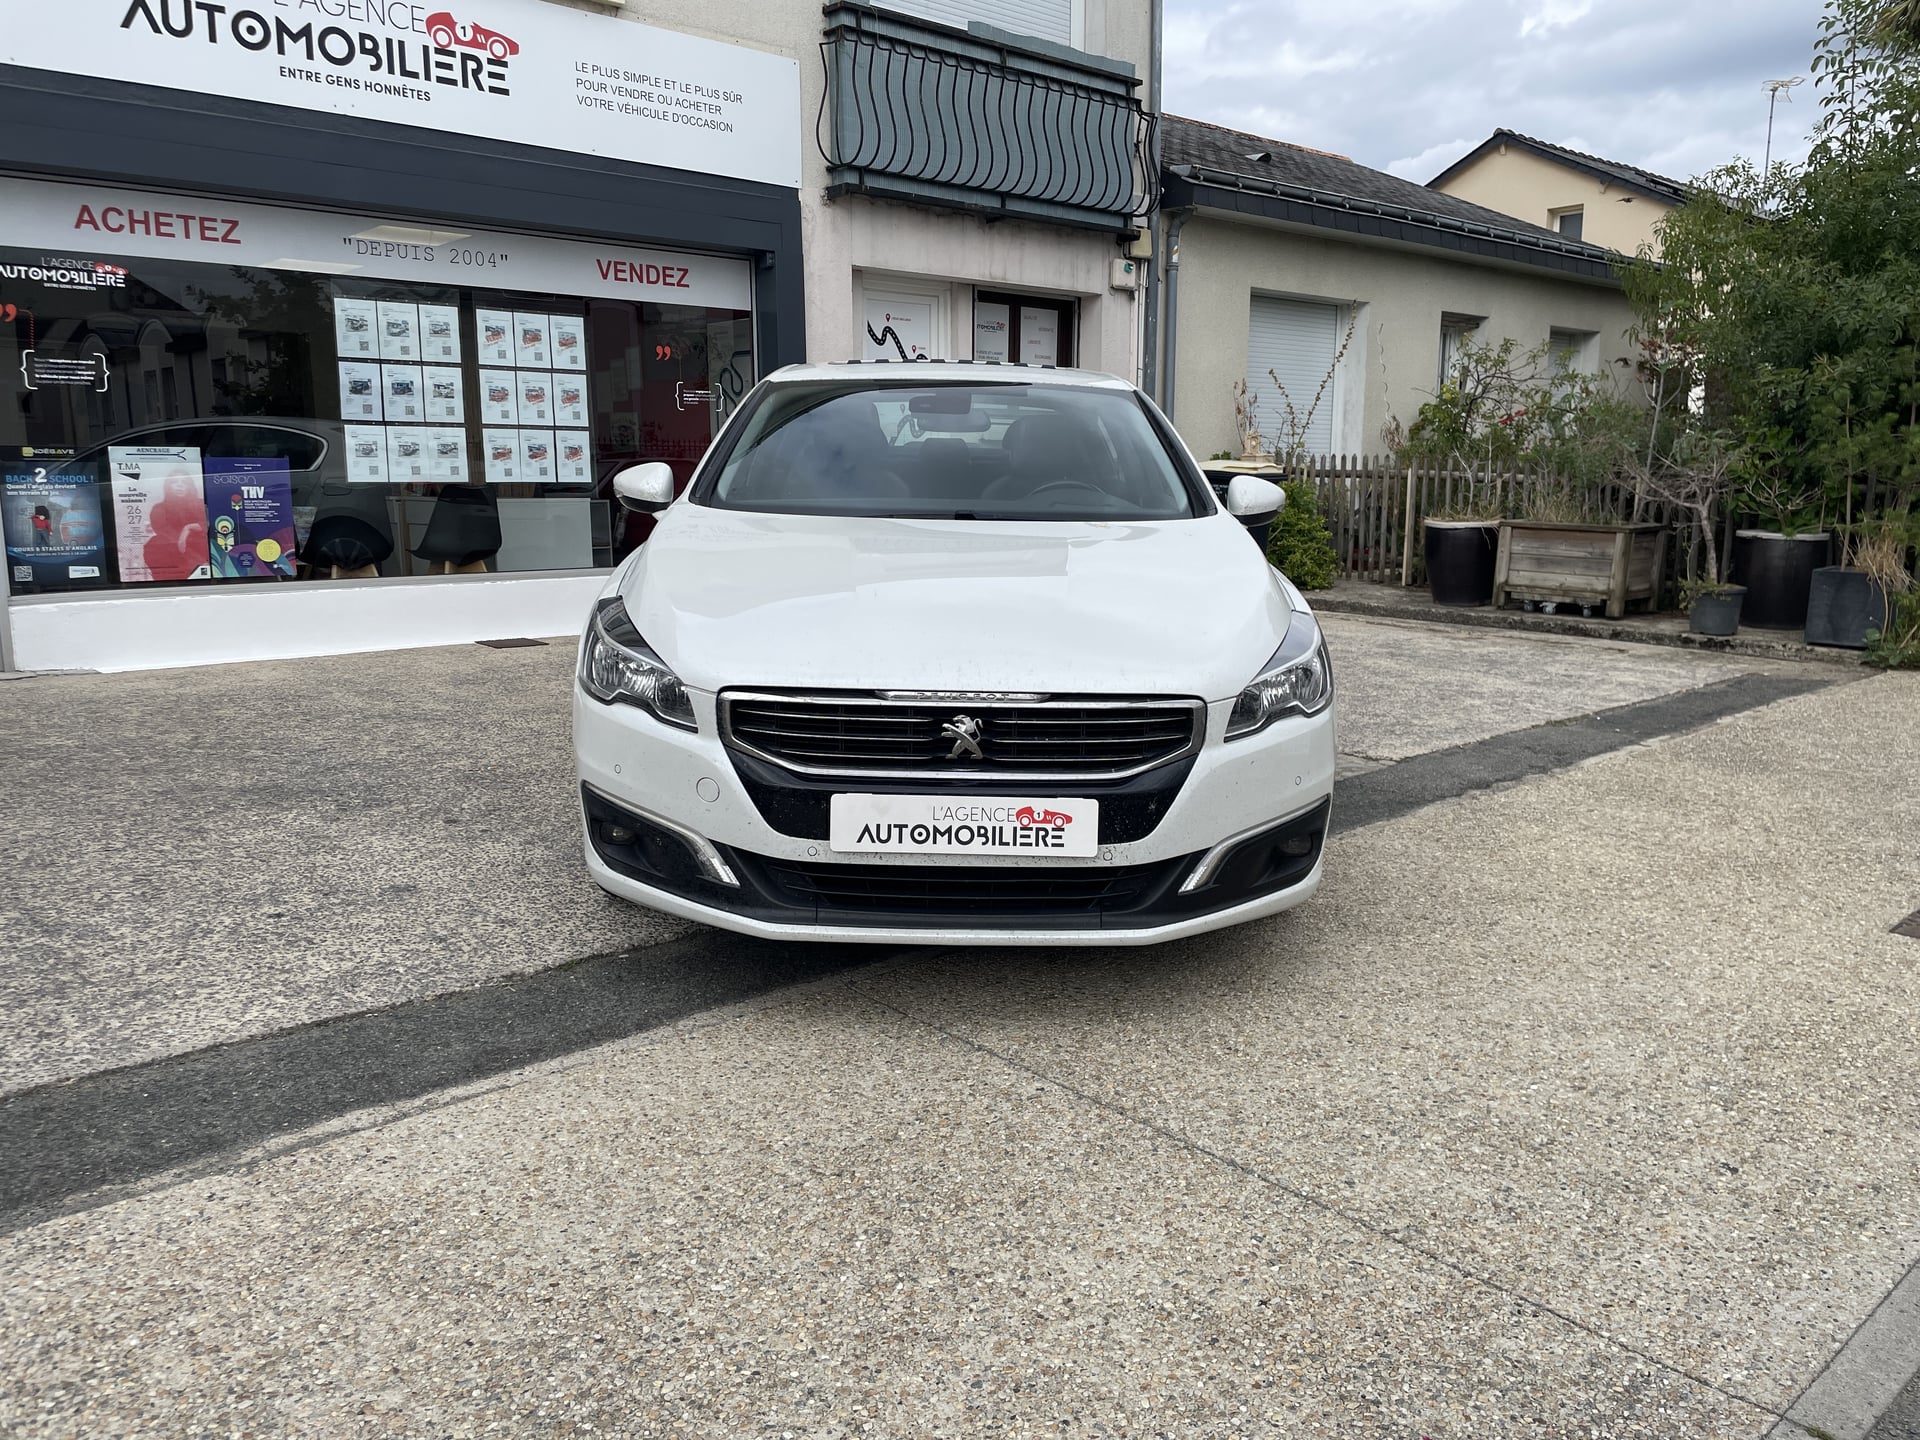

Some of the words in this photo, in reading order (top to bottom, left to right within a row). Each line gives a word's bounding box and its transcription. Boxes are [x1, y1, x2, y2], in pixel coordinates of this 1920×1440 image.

[280, 66, 322, 83] ENTRE
[326, 74, 361, 90] GENS
[364, 80, 431, 102] HONNÊTES
[575, 61, 589, 74] LE
[591, 64, 620, 79] PLUS
[623, 71, 661, 88] SIMPLE
[664, 79, 677, 90] ET
[680, 82, 692, 94] LE
[694, 85, 720, 100] PLUS
[722, 91, 743, 104] SÛR
[576, 78, 608, 93] POUR
[610, 85, 654, 102] VENDRE
[657, 94, 673, 106] OU
[675, 98, 722, 116] ACHETER
[576, 95, 614, 112] VOTRE
[617, 102, 669, 121] VÉHICULE
[672, 112, 733, 133] D'OCCASION
[74, 204, 241, 244] ACHETEZ
[41, 257, 95, 271] L'AGENCE
[596, 258, 690, 288] VENDEZ
[34, 467, 47, 483] 2
[49, 475, 89, 483] SCHOOL
[127, 505, 142, 514] 26
[128, 515, 142, 524] 27
[932, 806, 1016, 822] L'AGENCE
